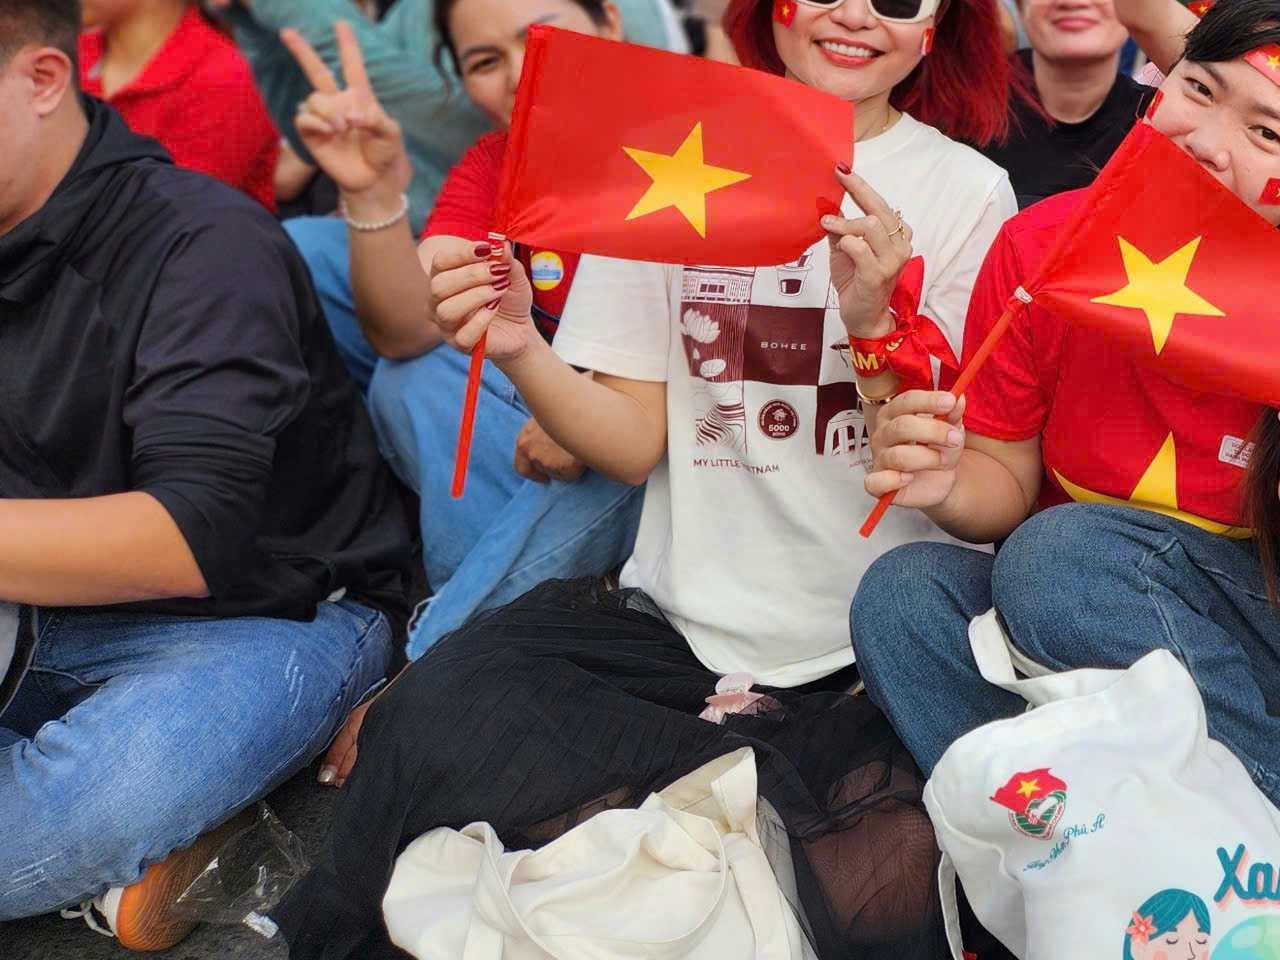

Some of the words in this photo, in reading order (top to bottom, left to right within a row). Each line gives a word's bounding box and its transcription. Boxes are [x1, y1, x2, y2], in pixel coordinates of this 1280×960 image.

[760, 341, 807, 351] BOHEE
[694, 458, 709, 467] MY
[711, 458, 741, 468] LITTLE
